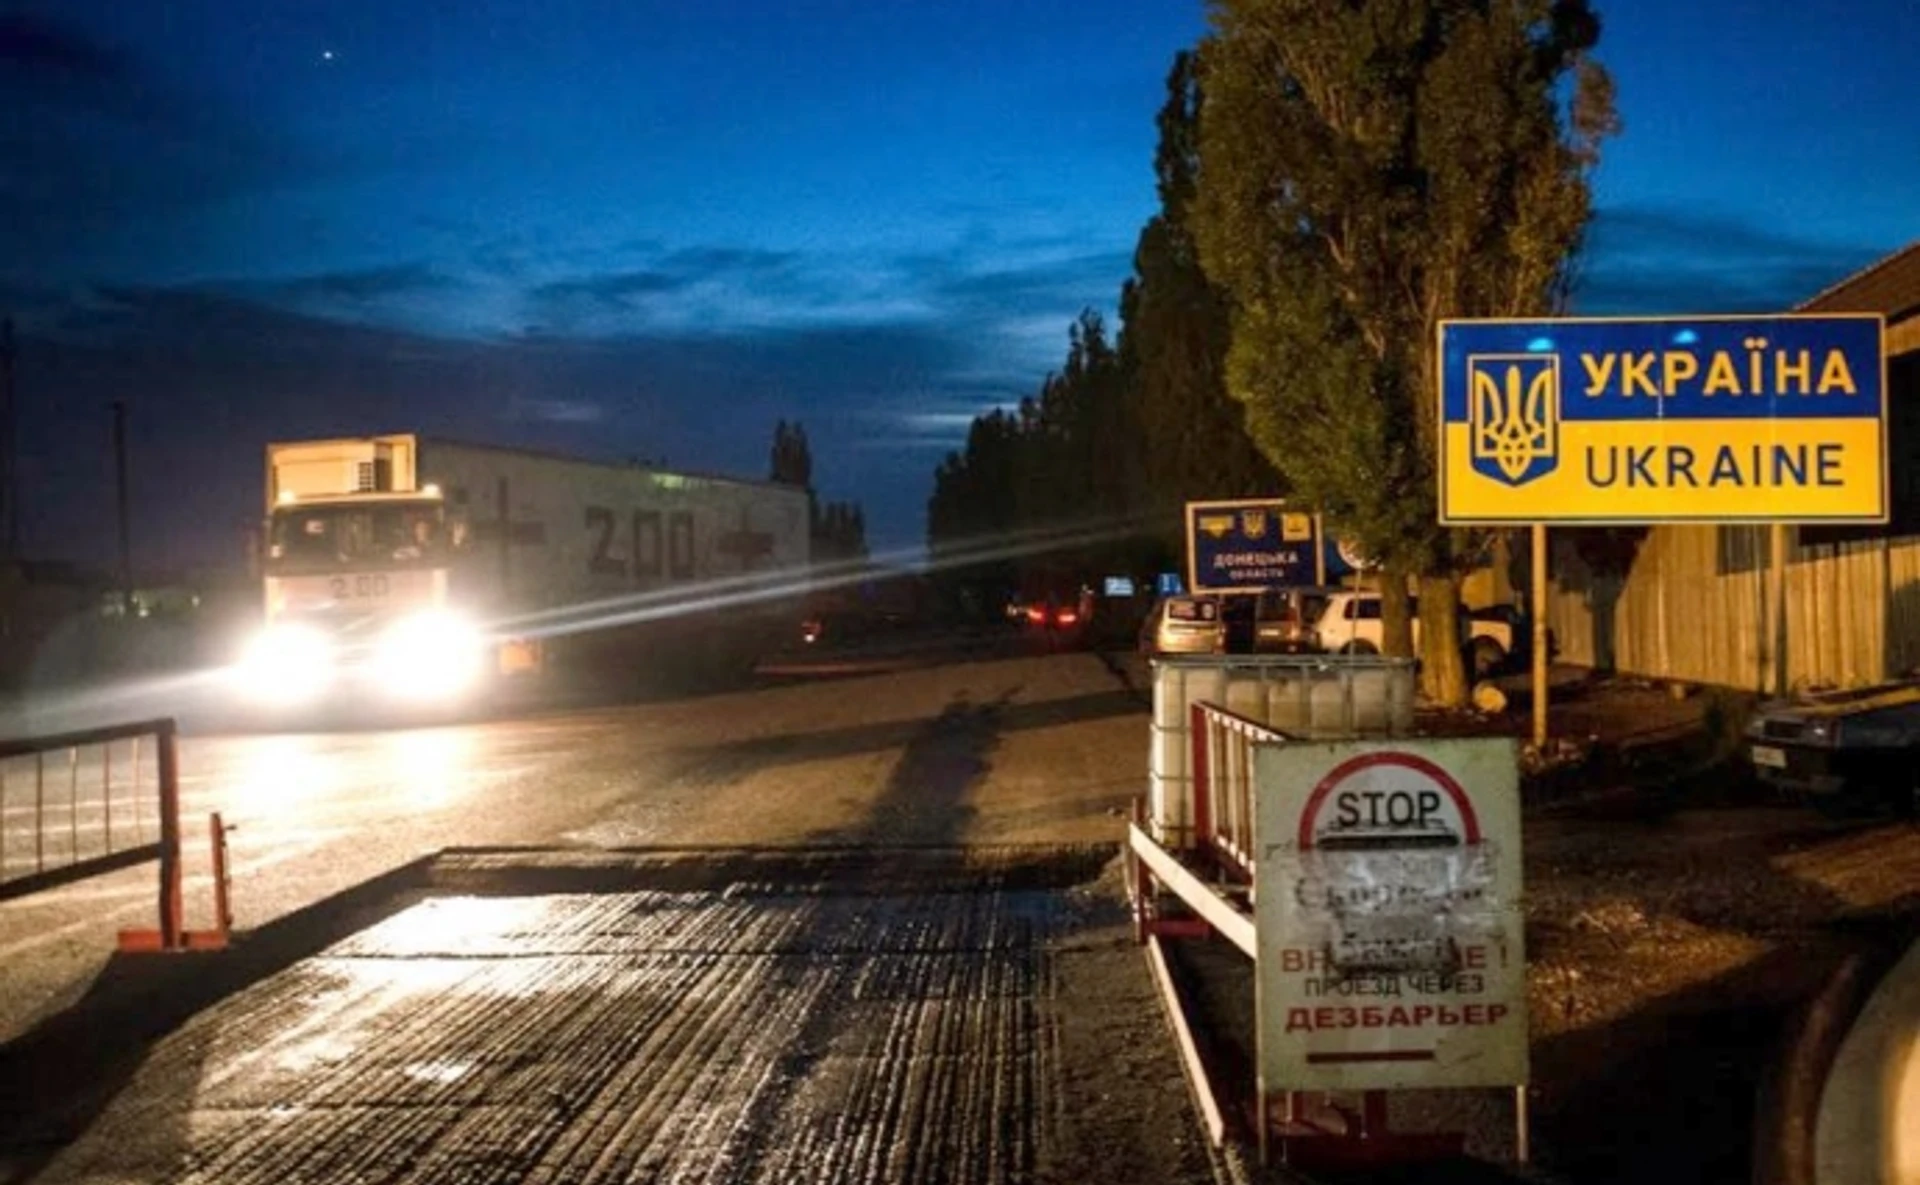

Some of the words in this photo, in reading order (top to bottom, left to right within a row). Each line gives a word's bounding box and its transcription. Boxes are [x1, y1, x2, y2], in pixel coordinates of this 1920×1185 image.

[1580, 337, 1857, 397] УКРАЇНА
[1585, 444, 1845, 487] UKRAINE
[584, 505, 695, 579] 200
[1213, 551, 1299, 568] ДОНЕЦЬКА
[1336, 789, 1442, 828] STOP
[1304, 974, 1402, 998] ПРОЕЗД
[1407, 973, 1486, 995] ЧЕРЕЗ
[1285, 1002, 1509, 1033] ДЕЗБАРЬЕР
